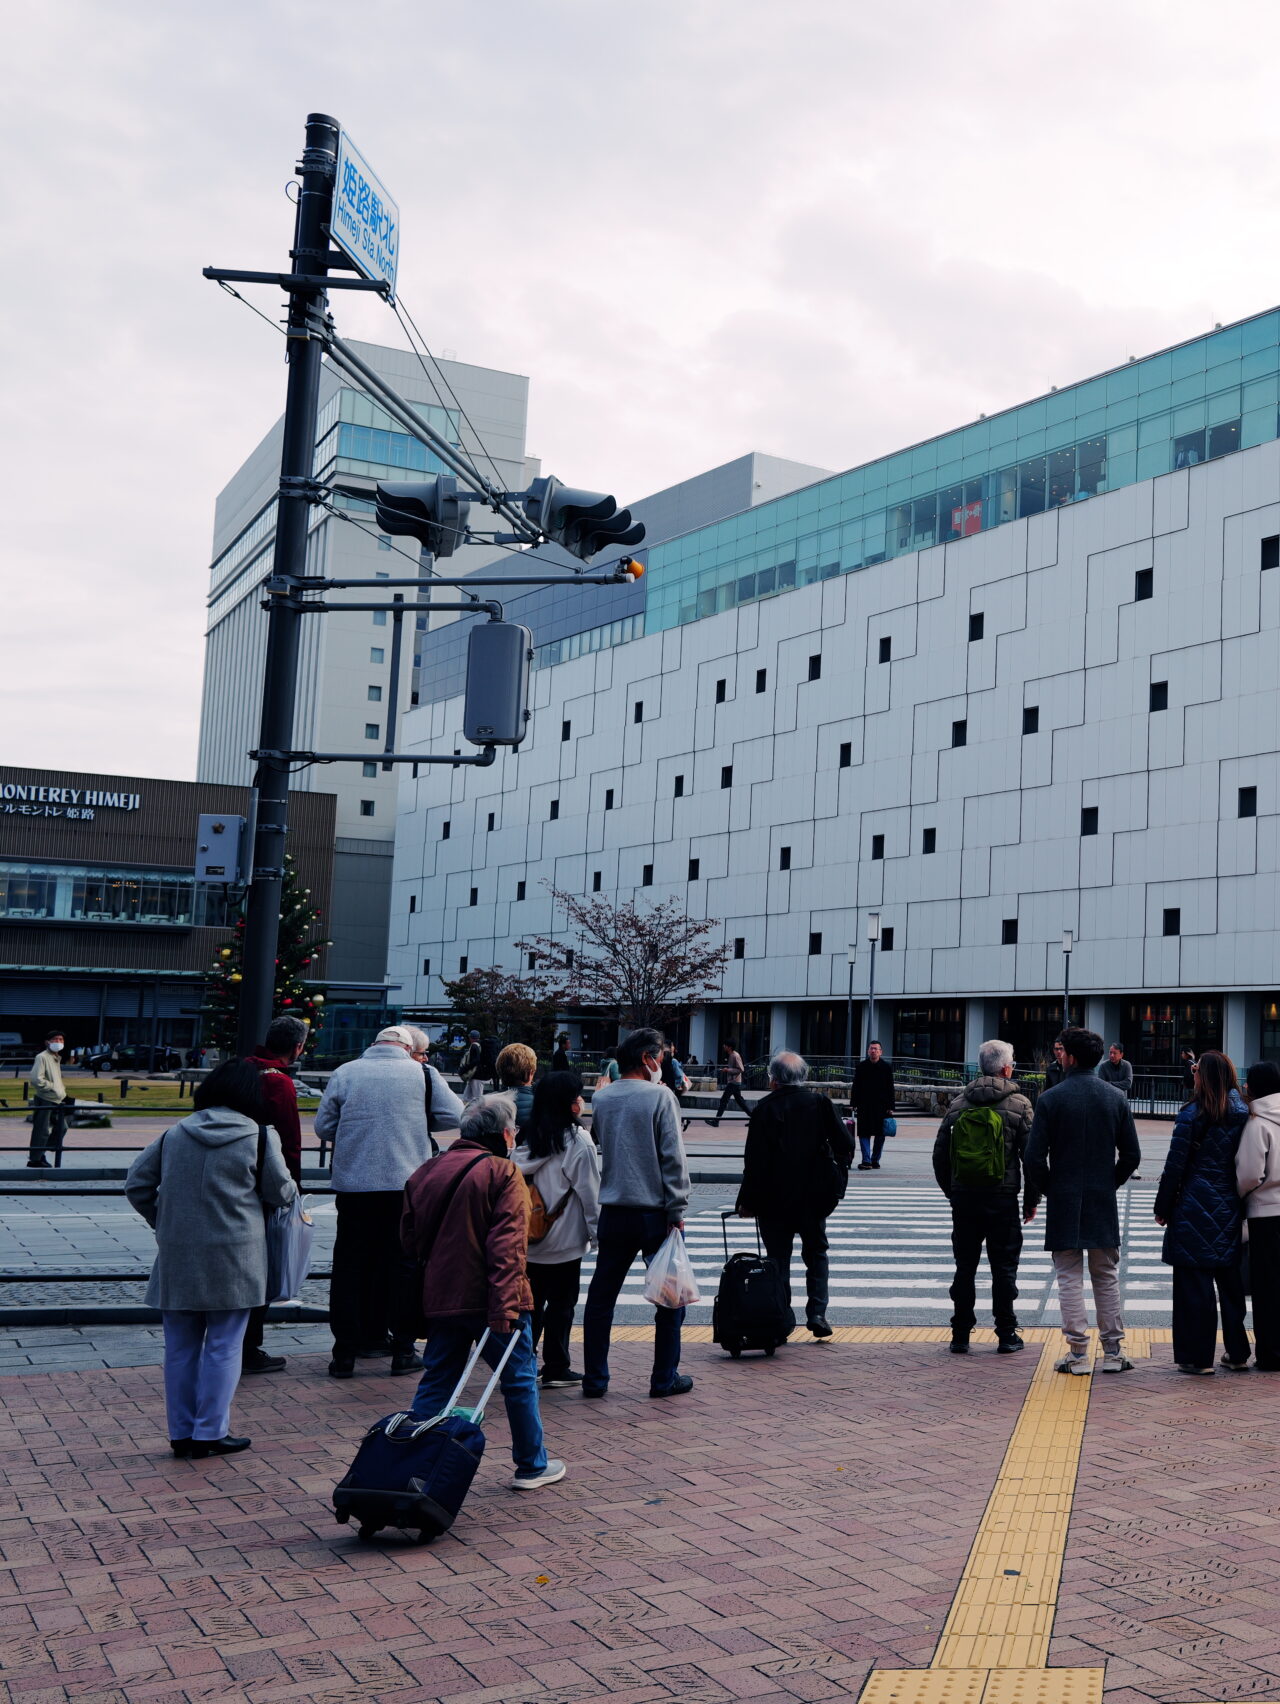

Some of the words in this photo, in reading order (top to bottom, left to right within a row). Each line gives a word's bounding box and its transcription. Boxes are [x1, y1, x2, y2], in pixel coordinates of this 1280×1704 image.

[342, 156, 395, 256] 姫路駅北
[336, 195, 362, 246] Himeji
[362, 227, 376, 264] Sta.
[376, 246, 395, 284] North
[0, 783, 81, 804] ONTEREY
[85, 790, 140, 811] HIMEJI
[0, 802, 63, 817] ルモントレ
